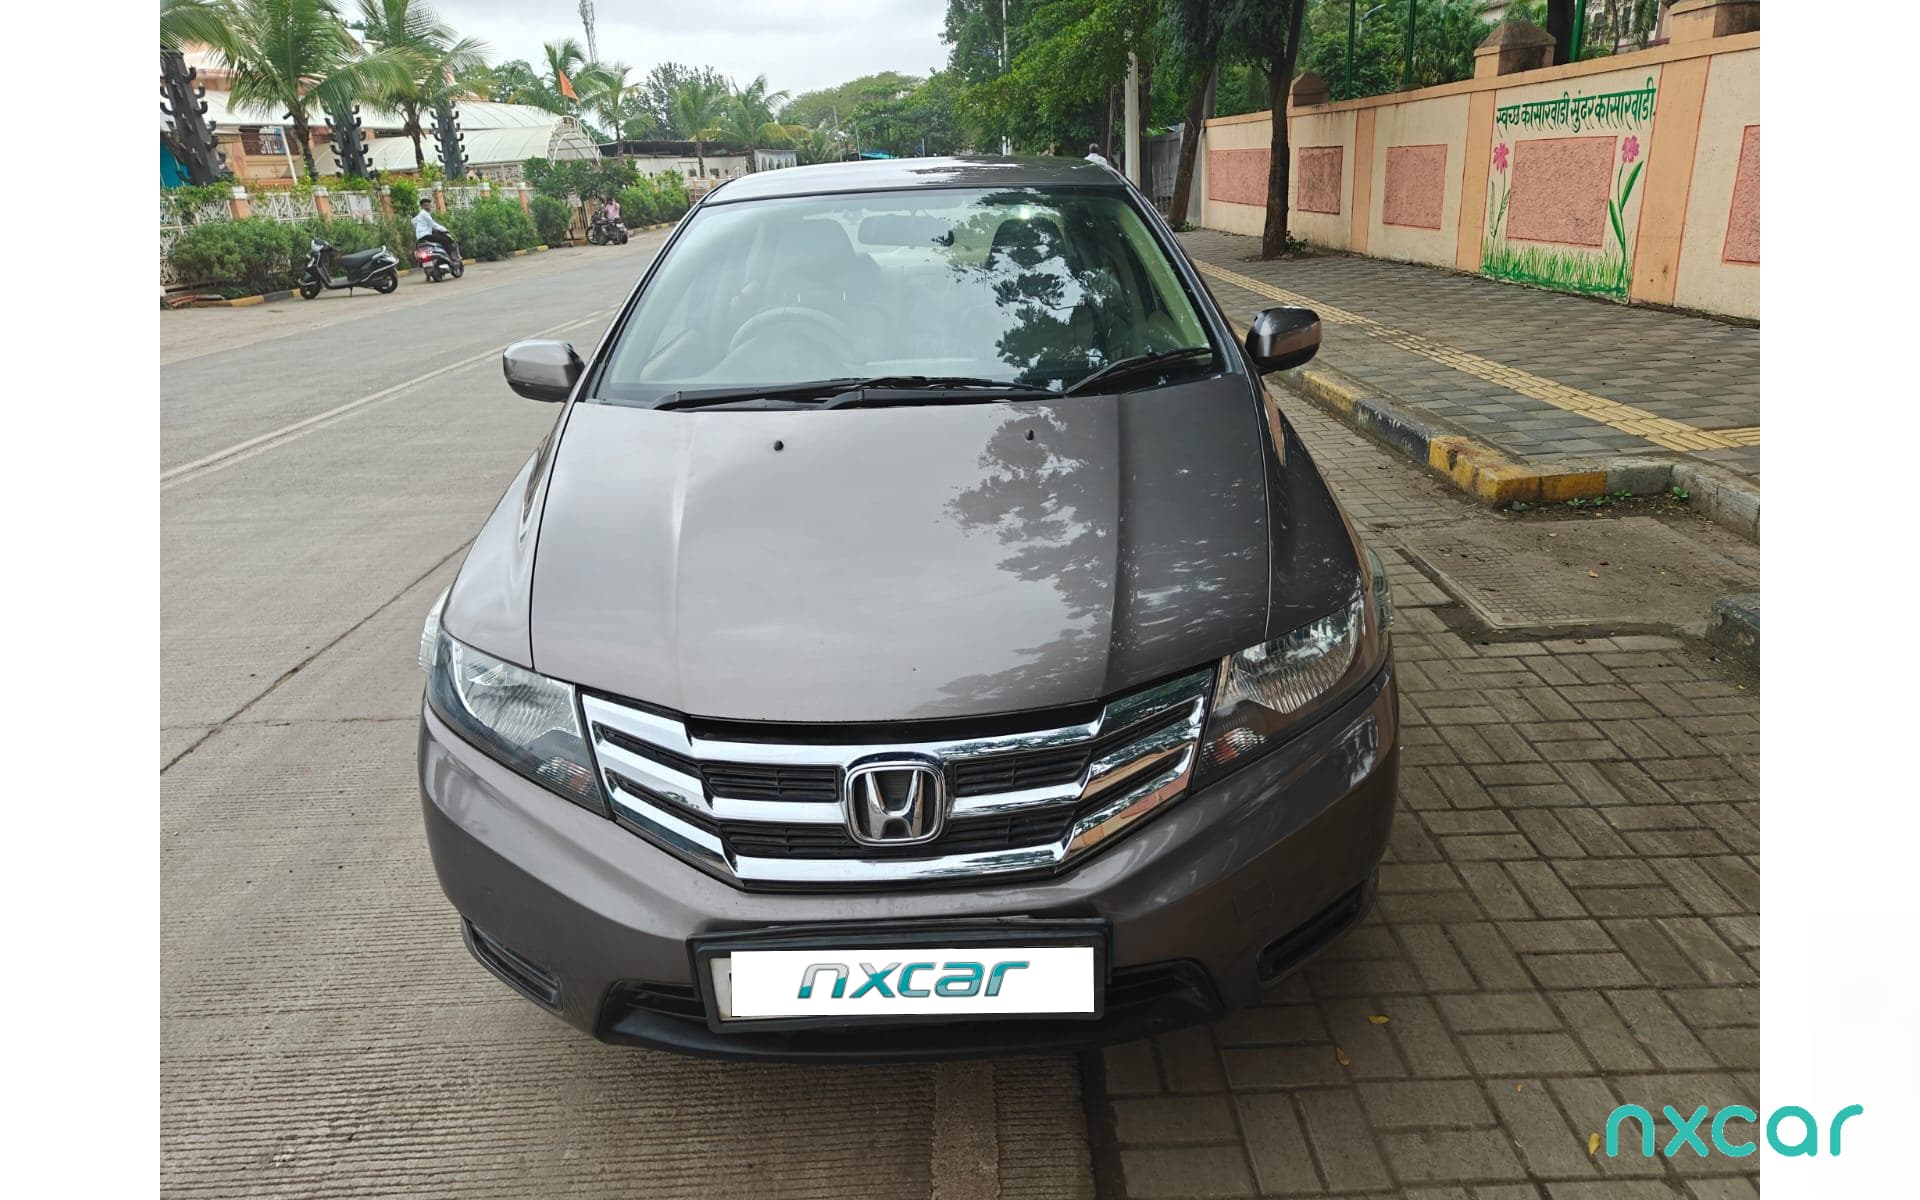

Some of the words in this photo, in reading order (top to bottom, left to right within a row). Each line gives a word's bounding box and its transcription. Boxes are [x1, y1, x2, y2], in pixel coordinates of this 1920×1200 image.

[1496, 105, 1521, 136] स्वच्छ
[1521, 91, 1570, 131] कासारवाडी
[1571, 90, 1596, 133] सुंदर
